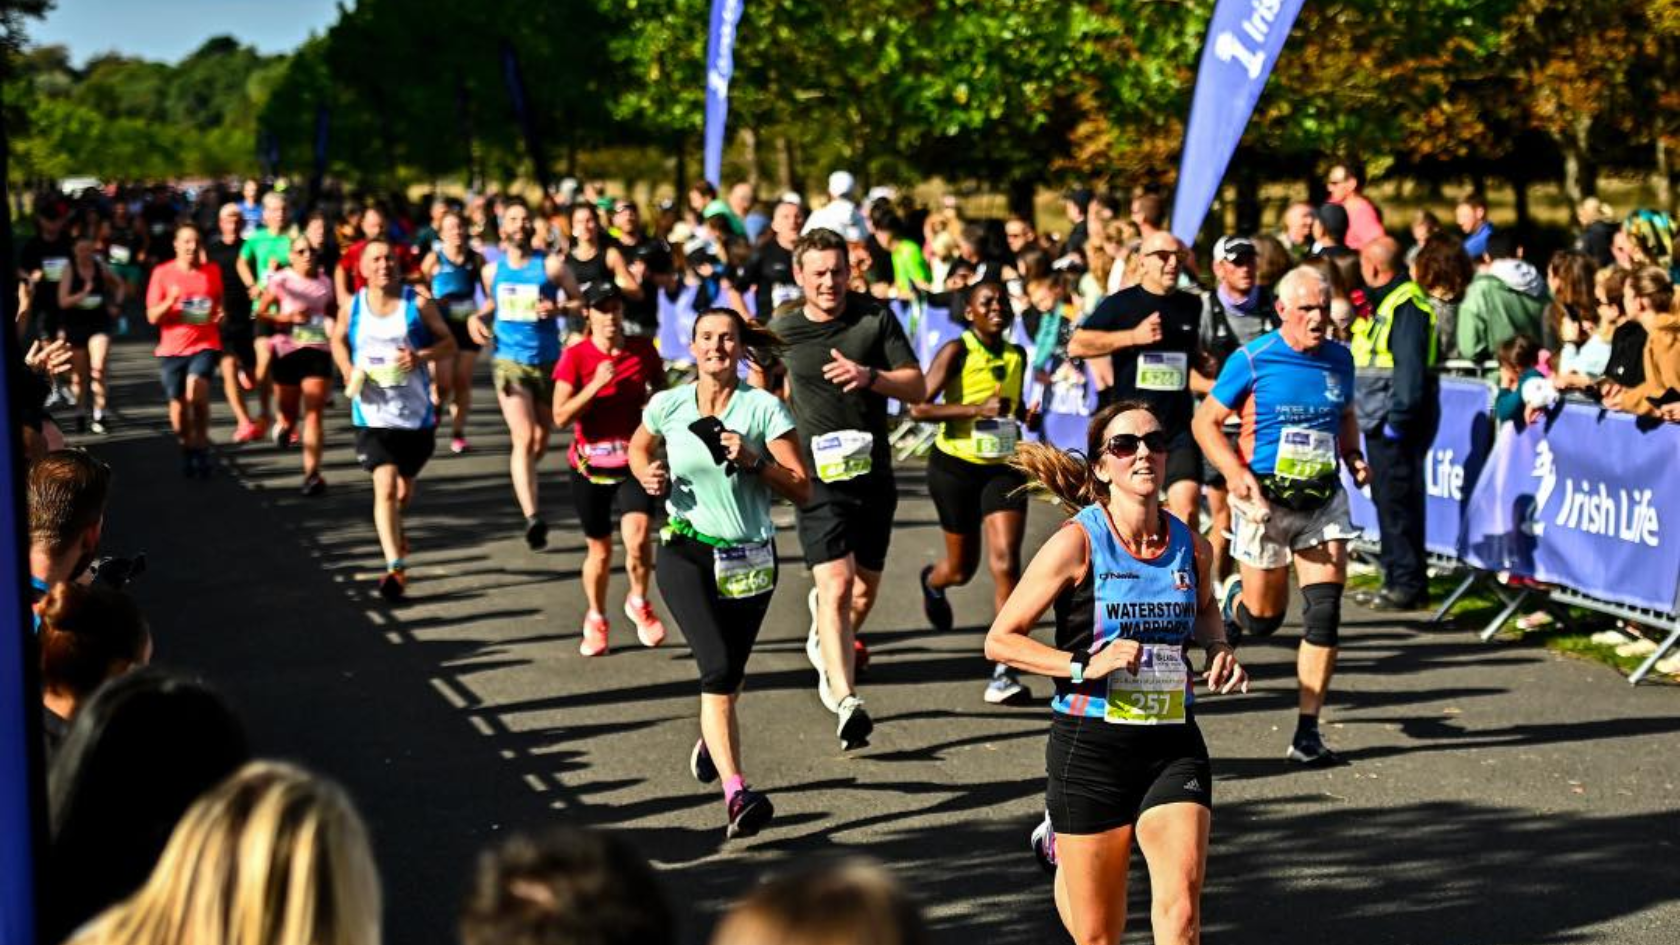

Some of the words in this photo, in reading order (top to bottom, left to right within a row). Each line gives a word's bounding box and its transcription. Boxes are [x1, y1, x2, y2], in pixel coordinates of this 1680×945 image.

[1427, 449, 1465, 501] Life
[1555, 478, 1616, 537] Irish
[1619, 488, 1660, 547] Life
[1130, 693, 1171, 715] 257
